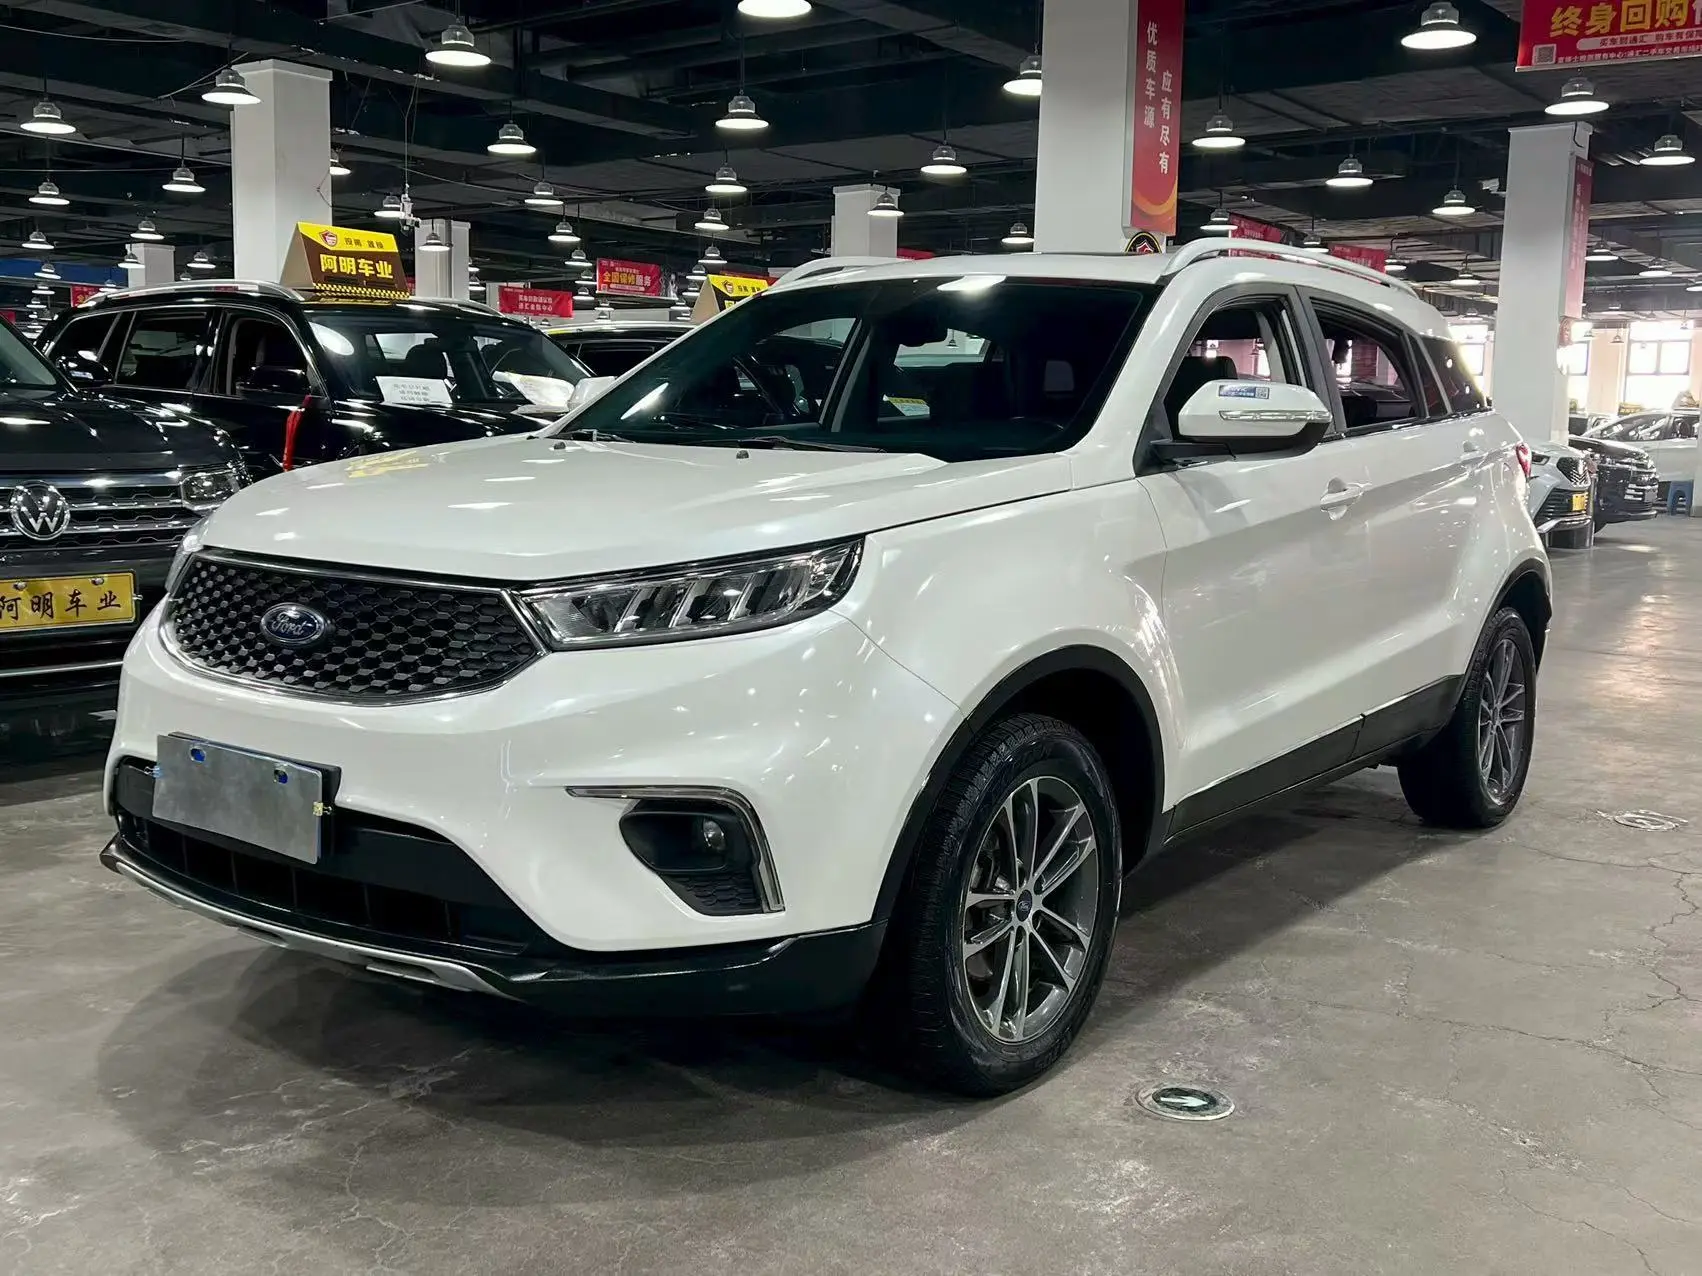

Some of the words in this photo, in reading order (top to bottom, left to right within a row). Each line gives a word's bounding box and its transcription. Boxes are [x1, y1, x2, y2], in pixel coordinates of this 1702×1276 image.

[1550, 0, 1702, 38] 终身回购
[1143, 20, 1159, 129] 优质车源
[1158, 69, 1173, 175] 应有尽有
[319, 253, 394, 279] 阿明车业
[271, 610, 314, 636] Ford
